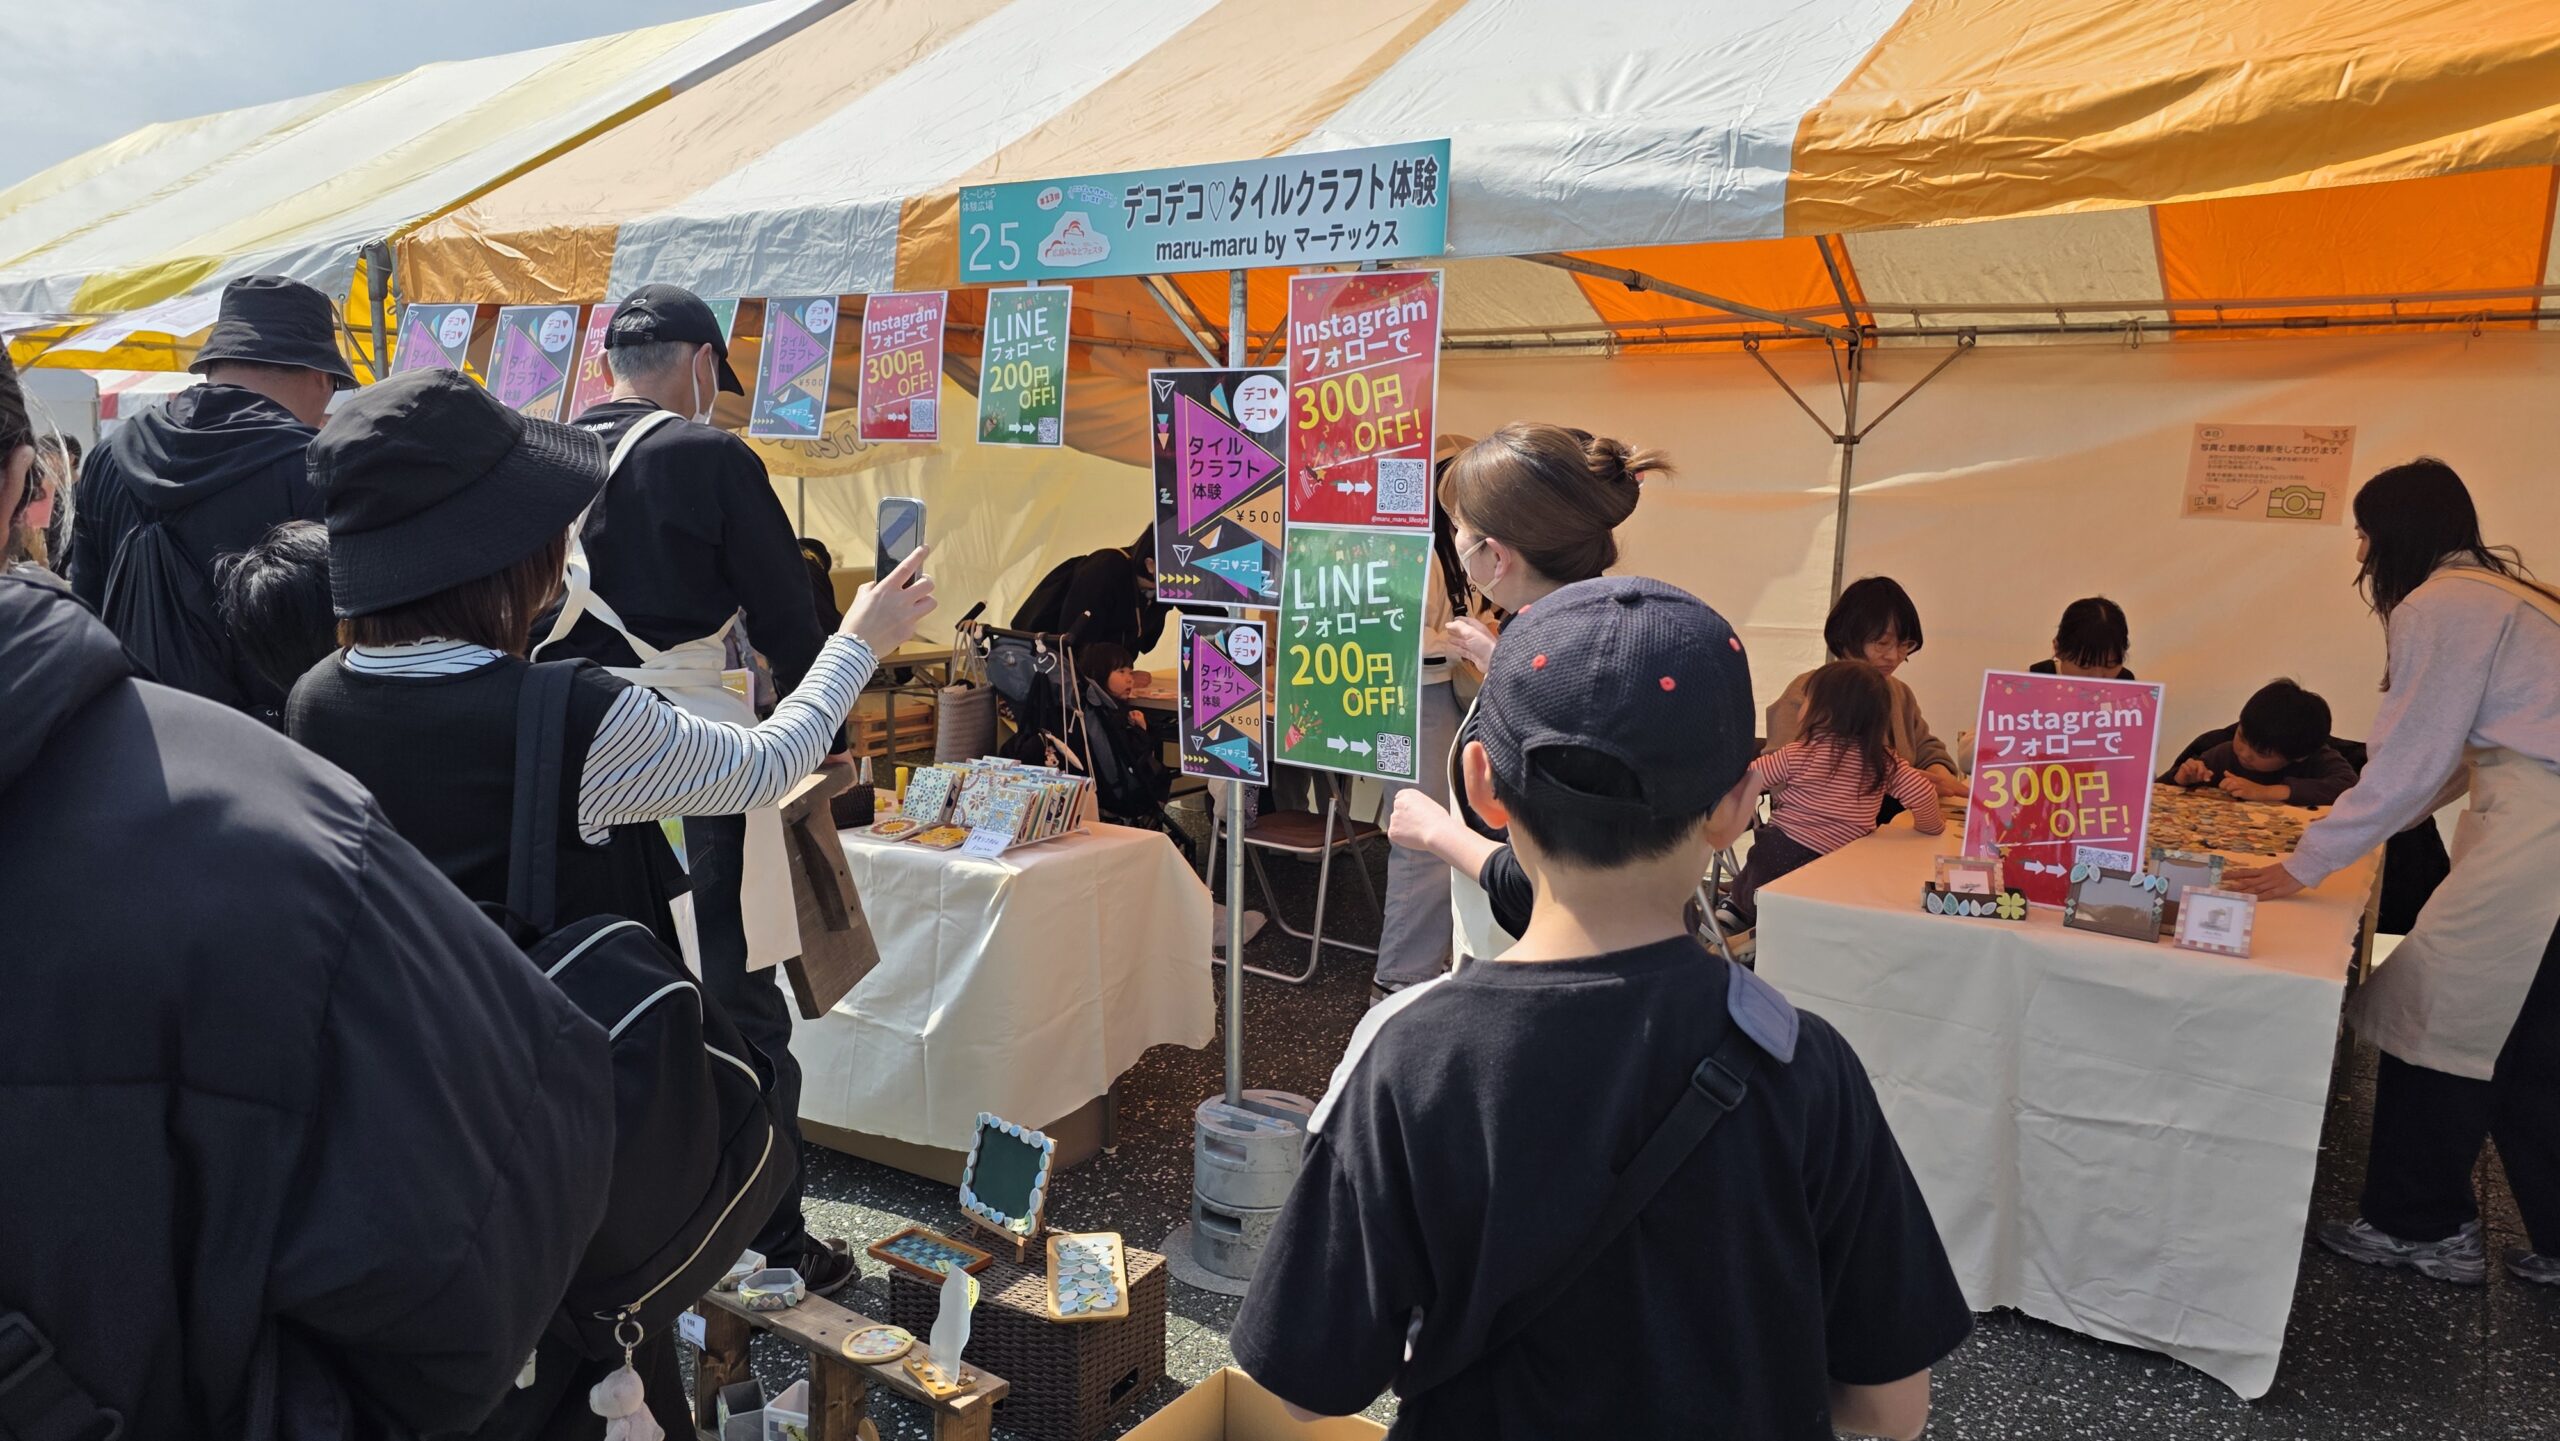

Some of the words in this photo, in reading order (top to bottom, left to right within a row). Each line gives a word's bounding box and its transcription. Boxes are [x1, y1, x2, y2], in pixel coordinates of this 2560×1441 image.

[969, 221, 1020, 271] 25
[1156, 236, 1257, 261] maru-maru
[1264, 230, 1287, 260] by
[1294, 219, 1399, 252] マーテックス
[868, 307, 937, 334] Instagram
[993, 307, 1048, 344] LINE
[1295, 299, 1428, 346] Instagram
[871, 324, 928, 350] フォローで
[991, 336, 1056, 362] フォローで
[1302, 328, 1411, 372] フォローで
[867, 350, 924, 384] 300円
[990, 360, 1049, 393] 200円
[897, 370, 934, 397] OFF!
[1019, 385, 1056, 409] OFF!
[1294, 372, 1404, 430] 300円
[1188, 436, 1243, 456] タイル
[1354, 409, 1423, 452] OFF!
[1189, 458, 1260, 479] クラフト
[1192, 483, 1222, 501] 体験
[1293, 560, 1390, 610] LINE
[1291, 607, 1405, 638] フォローで
[1200, 663, 1235, 679] タイル
[1289, 641, 1394, 686] 200円
[1201, 679, 1245, 695] クラフト
[1202, 695, 1221, 708] 体験
[1342, 686, 1406, 717] OFF!
[1987, 707, 2143, 734] Instagram
[1994, 731, 2122, 756] フォローで
[1982, 764, 2111, 809] 300円
[2050, 805, 2131, 837] OFF!
